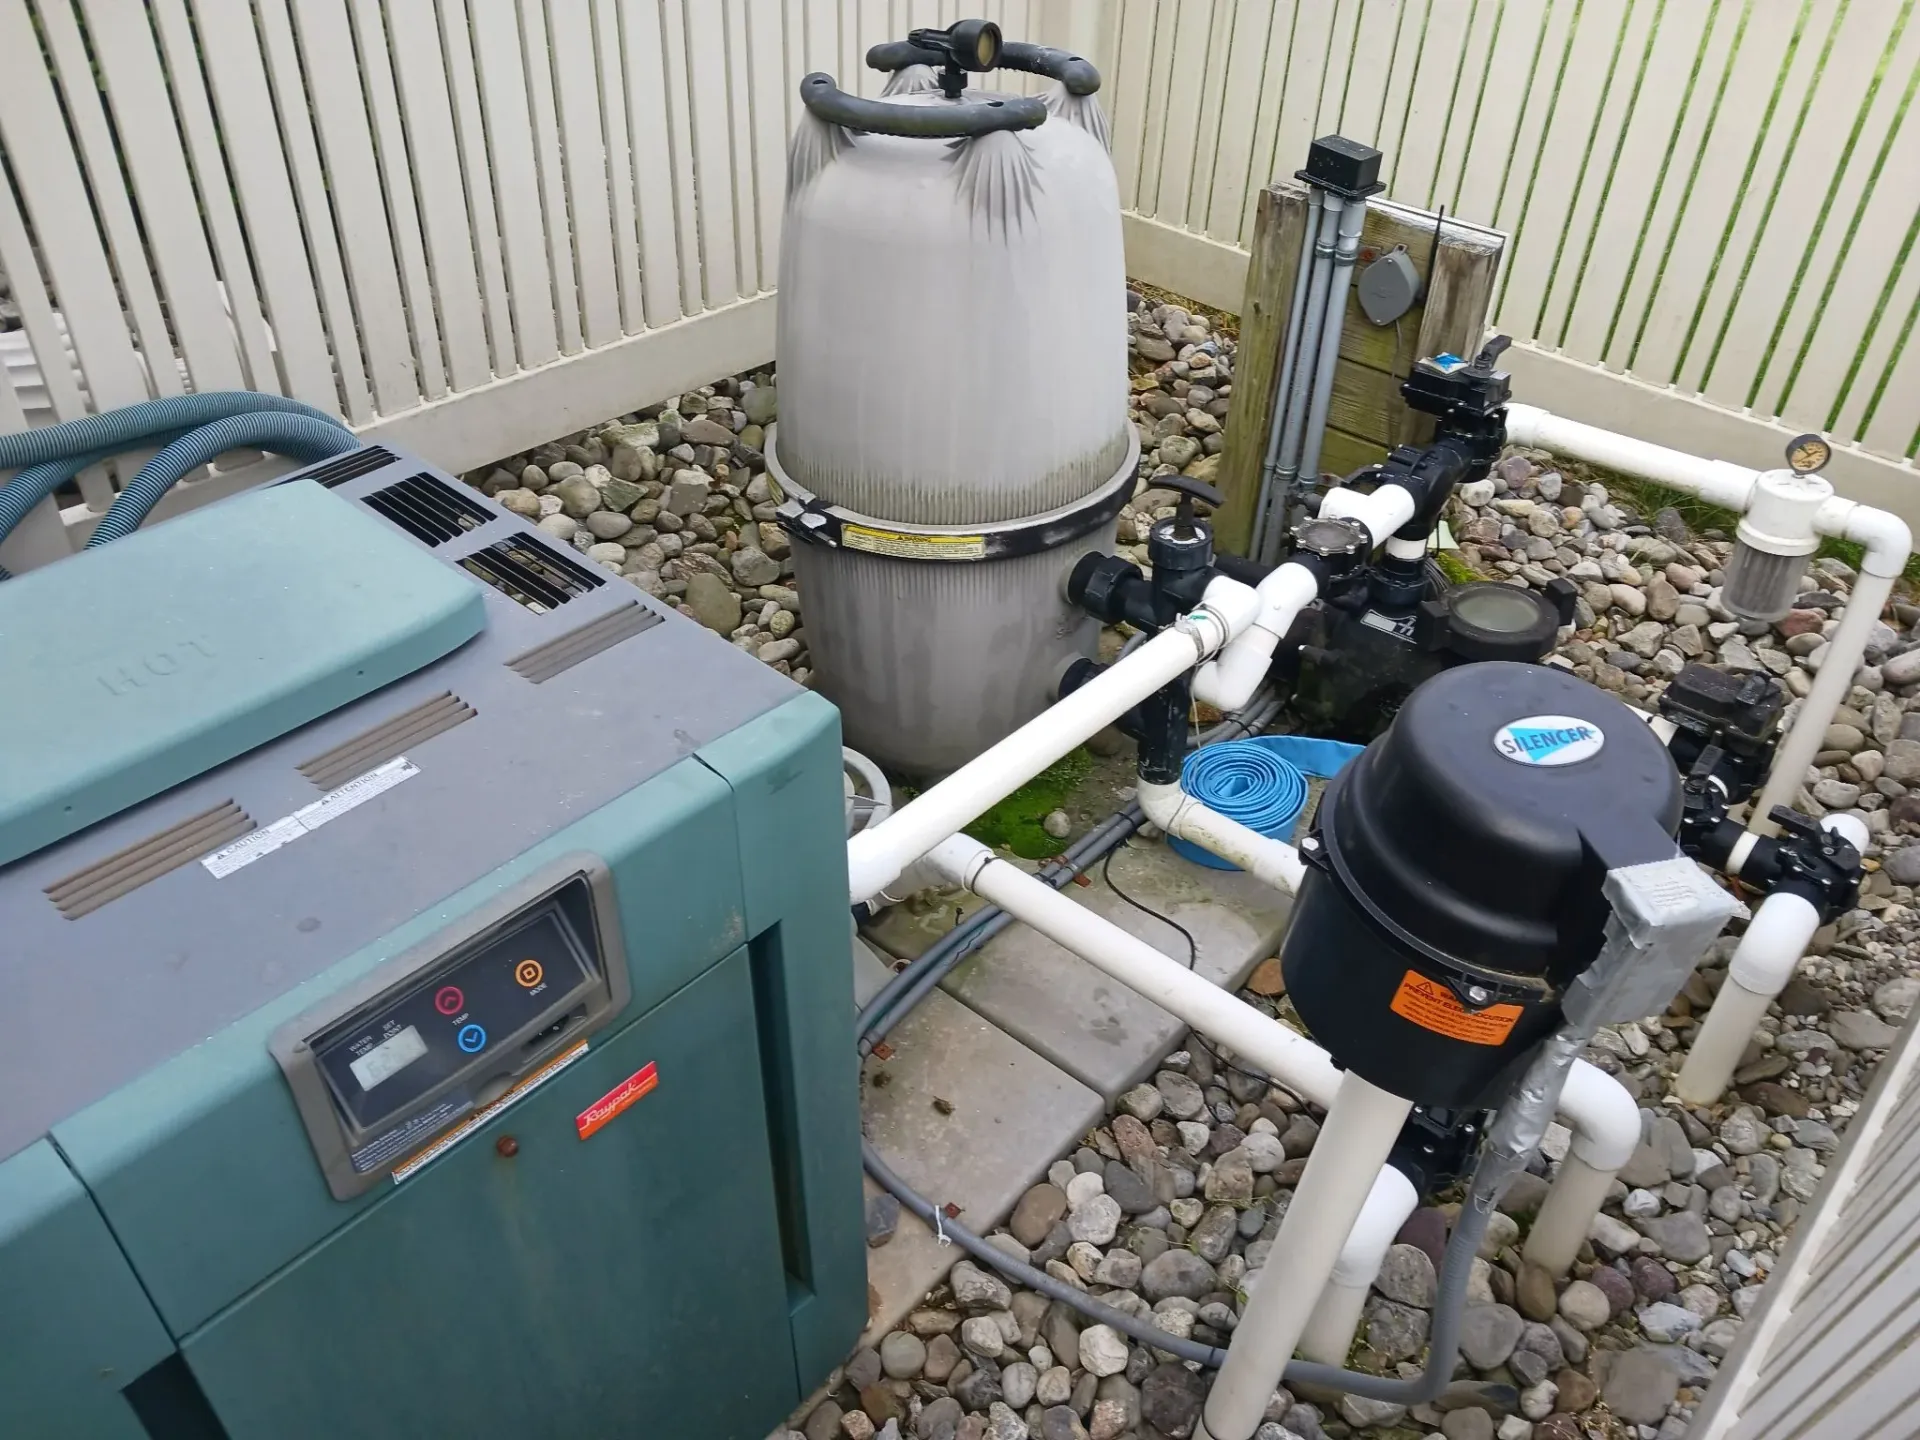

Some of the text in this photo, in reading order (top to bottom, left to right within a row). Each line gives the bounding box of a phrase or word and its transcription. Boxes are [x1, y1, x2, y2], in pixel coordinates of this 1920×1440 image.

[96, 634, 218, 697] HOT
[1501, 725, 1593, 755] SILENCER
[329, 771, 379, 802] ATTENTION
[225, 828, 270, 855] CAUTION
[451, 1012, 470, 1026] TEMP
[583, 1081, 636, 1126] Raypak
